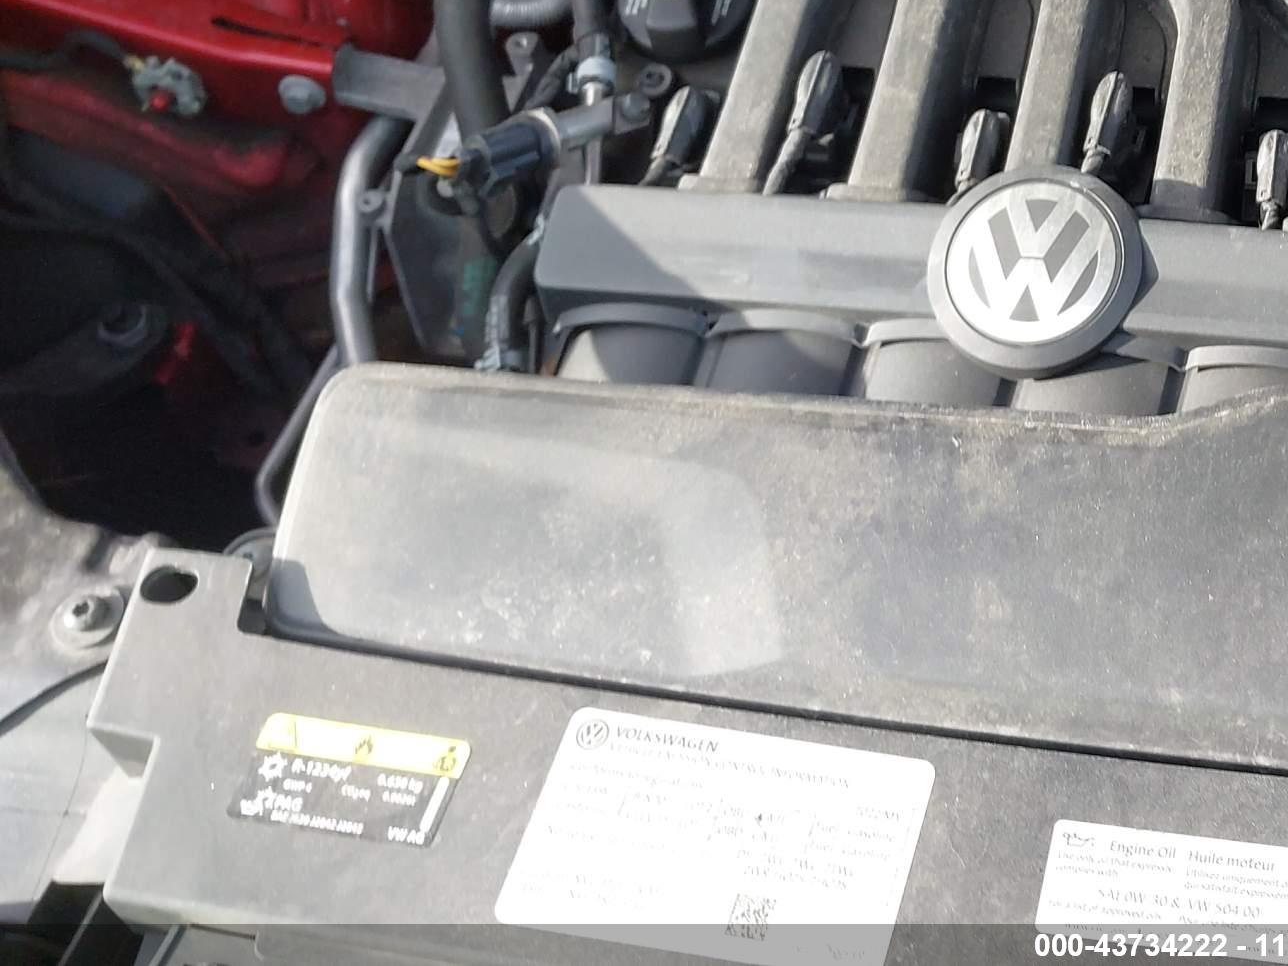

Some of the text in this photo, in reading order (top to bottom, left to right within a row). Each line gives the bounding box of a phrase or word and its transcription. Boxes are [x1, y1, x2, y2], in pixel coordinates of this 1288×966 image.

[616, 724, 720, 753] VOLKSWAGEN
[1110, 840, 1275, 872] Engine Oil Huile moteur
[1170, 896, 1181, 910] &
[1215, 903, 1240, 915] 504
